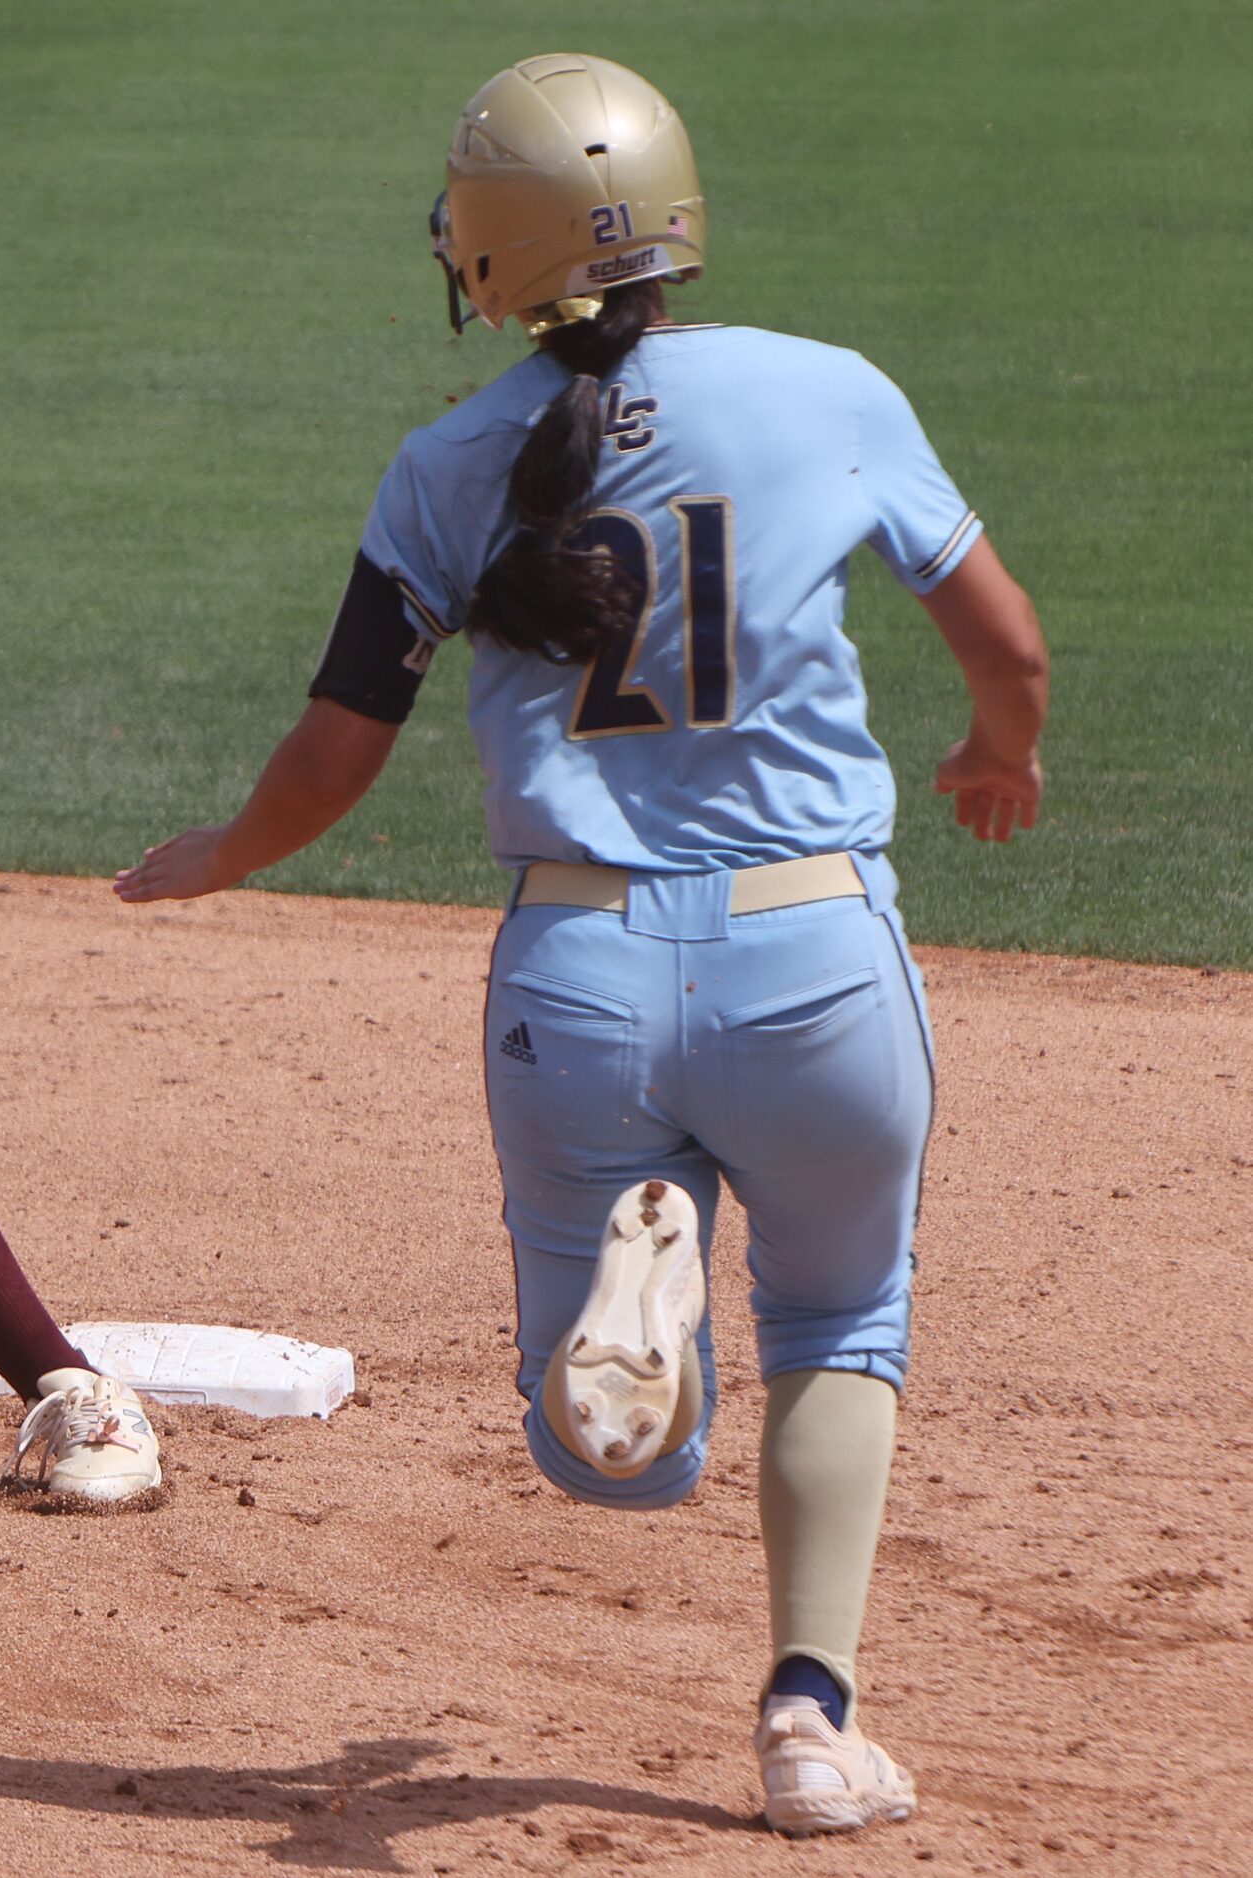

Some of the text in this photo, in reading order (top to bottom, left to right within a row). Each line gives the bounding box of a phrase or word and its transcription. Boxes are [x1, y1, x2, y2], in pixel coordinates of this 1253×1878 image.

[590, 200, 634, 246] 21
[601, 383, 659, 453] LC
[564, 495, 734, 740] 21
